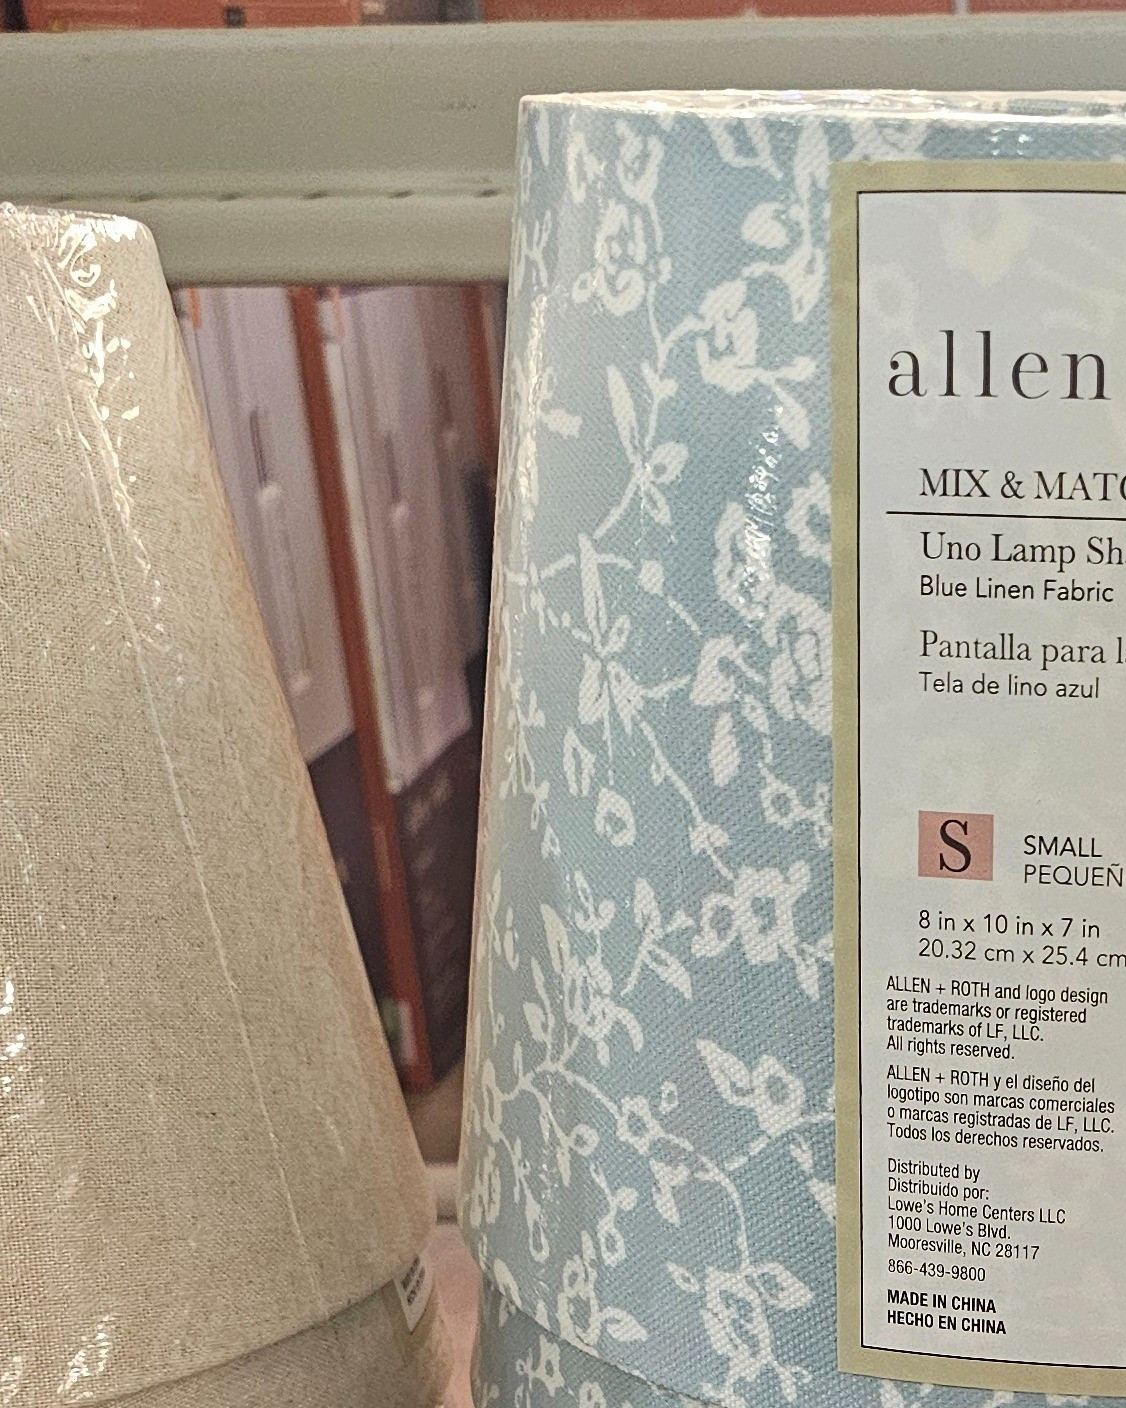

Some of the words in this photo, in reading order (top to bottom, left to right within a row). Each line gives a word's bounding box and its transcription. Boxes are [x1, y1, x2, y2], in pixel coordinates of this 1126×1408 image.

[888, 330, 1111, 400] allen
[919, 469, 990, 499] MIX
[1001, 471, 1025, 499] &
[920, 532, 981, 562] Uno
[991, 535, 1077, 569] Lamp
[920, 575, 967, 599] Blue
[976, 578, 1034, 601] Linen
[1043, 579, 1114, 603] Fabric
[920, 630, 1031, 664] Pantalla
[1042, 641, 1107, 671] para
[919, 671, 964, 695] Tela
[972, 673, 1000, 696] de
[1009, 675, 1047, 697] lino
[1055, 678, 1099, 699] azul
[939, 819, 971, 872] S
[1023, 835, 1103, 858] SMALL
[919, 910, 931, 929] 8
[938, 912, 956, 932] in
[984, 914, 1008, 935] 10
[1016, 917, 1034, 936] in
[1061, 918, 1074, 937] 7
[1082, 919, 1100, 939] in
[918, 938, 977, 960] 20.32
[984, 946, 1015, 962] cm
[1042, 945, 1088, 967] 25.4
[886, 976, 930, 994] ALLEN
[951, 980, 990, 997] ROTH
[995, 984, 1021, 1000] and
[1026, 985, 1055, 1005] logo
[1061, 987, 1108, 1006] design
[887, 999, 908, 1011] are
[913, 998, 991, 1018] trademarks
[996, 1007, 1010, 1019] or
[1015, 1007, 1087, 1024] registered
[887, 1016, 964, 1036] trademarks
[969, 1023, 983, 1037] of
[987, 1023, 1007, 1041] LF,
[1013, 1025, 1044, 1042] LLC.
[887, 1035, 903, 1051] All
[908, 1036, 946, 1056] rights
[950, 1041, 1015, 1059] reserved.
[887, 1065, 930, 1083] ALLEN
[951, 1070, 989, 1087] ROTH
[1006, 1076, 1017, 1089] el
[1023, 1076, 1068, 1092] diseño
[1073, 1077, 1095, 1093] del
[888, 1084, 940, 1105] logotipo
[944, 1092, 968, 1105] son
[973, 1094, 1024, 1109] marcas
[1029, 1097, 1115, 1114] comerciales
[899, 1107, 949, 1123] marcas
[954, 1111, 1030, 1130] registradas
[1036, 1114, 1052, 1130] de
[1057, 1116, 1078, 1134] LF,
[1083, 1117, 1115, 1133] LLC.
[887, 1122, 927, 1140] Todos
[932, 1125, 950, 1142] los
[955, 1128, 1017, 1148] derechos
[1023, 1134, 1104, 1152] reservados.
[888, 1158, 960, 1179] Distributed
[965, 1164, 980, 1183] by
[888, 1177, 958, 1198] Distribuido
[963, 1185, 989, 1201] por:
[888, 1196, 934, 1215] Lowe's
[939, 1201, 978, 1219] Home
[983, 1204, 1035, 1222] Centers
[1040, 1208, 1066, 1224] LLC
[889, 1216, 922, 1232] 1000
[926, 1219, 973, 1237] Lowe's
[978, 1222, 1010, 1239] Blvd.
[888, 1233, 966, 1257] Mooresville,
[972, 1242, 991, 1257] NC
[996, 1243, 1040, 1260] 28117
[888, 1259, 986, 1282] 866-439-9800
[887, 1289, 928, 1307] MADE
[933, 1294, 947, 1309] IN
[952, 1296, 996, 1313] CHINA
[887, 1310, 934, 1328] HECHO
[939, 1316, 956, 1331] EN
[961, 1318, 1006, 1335] CHINA
